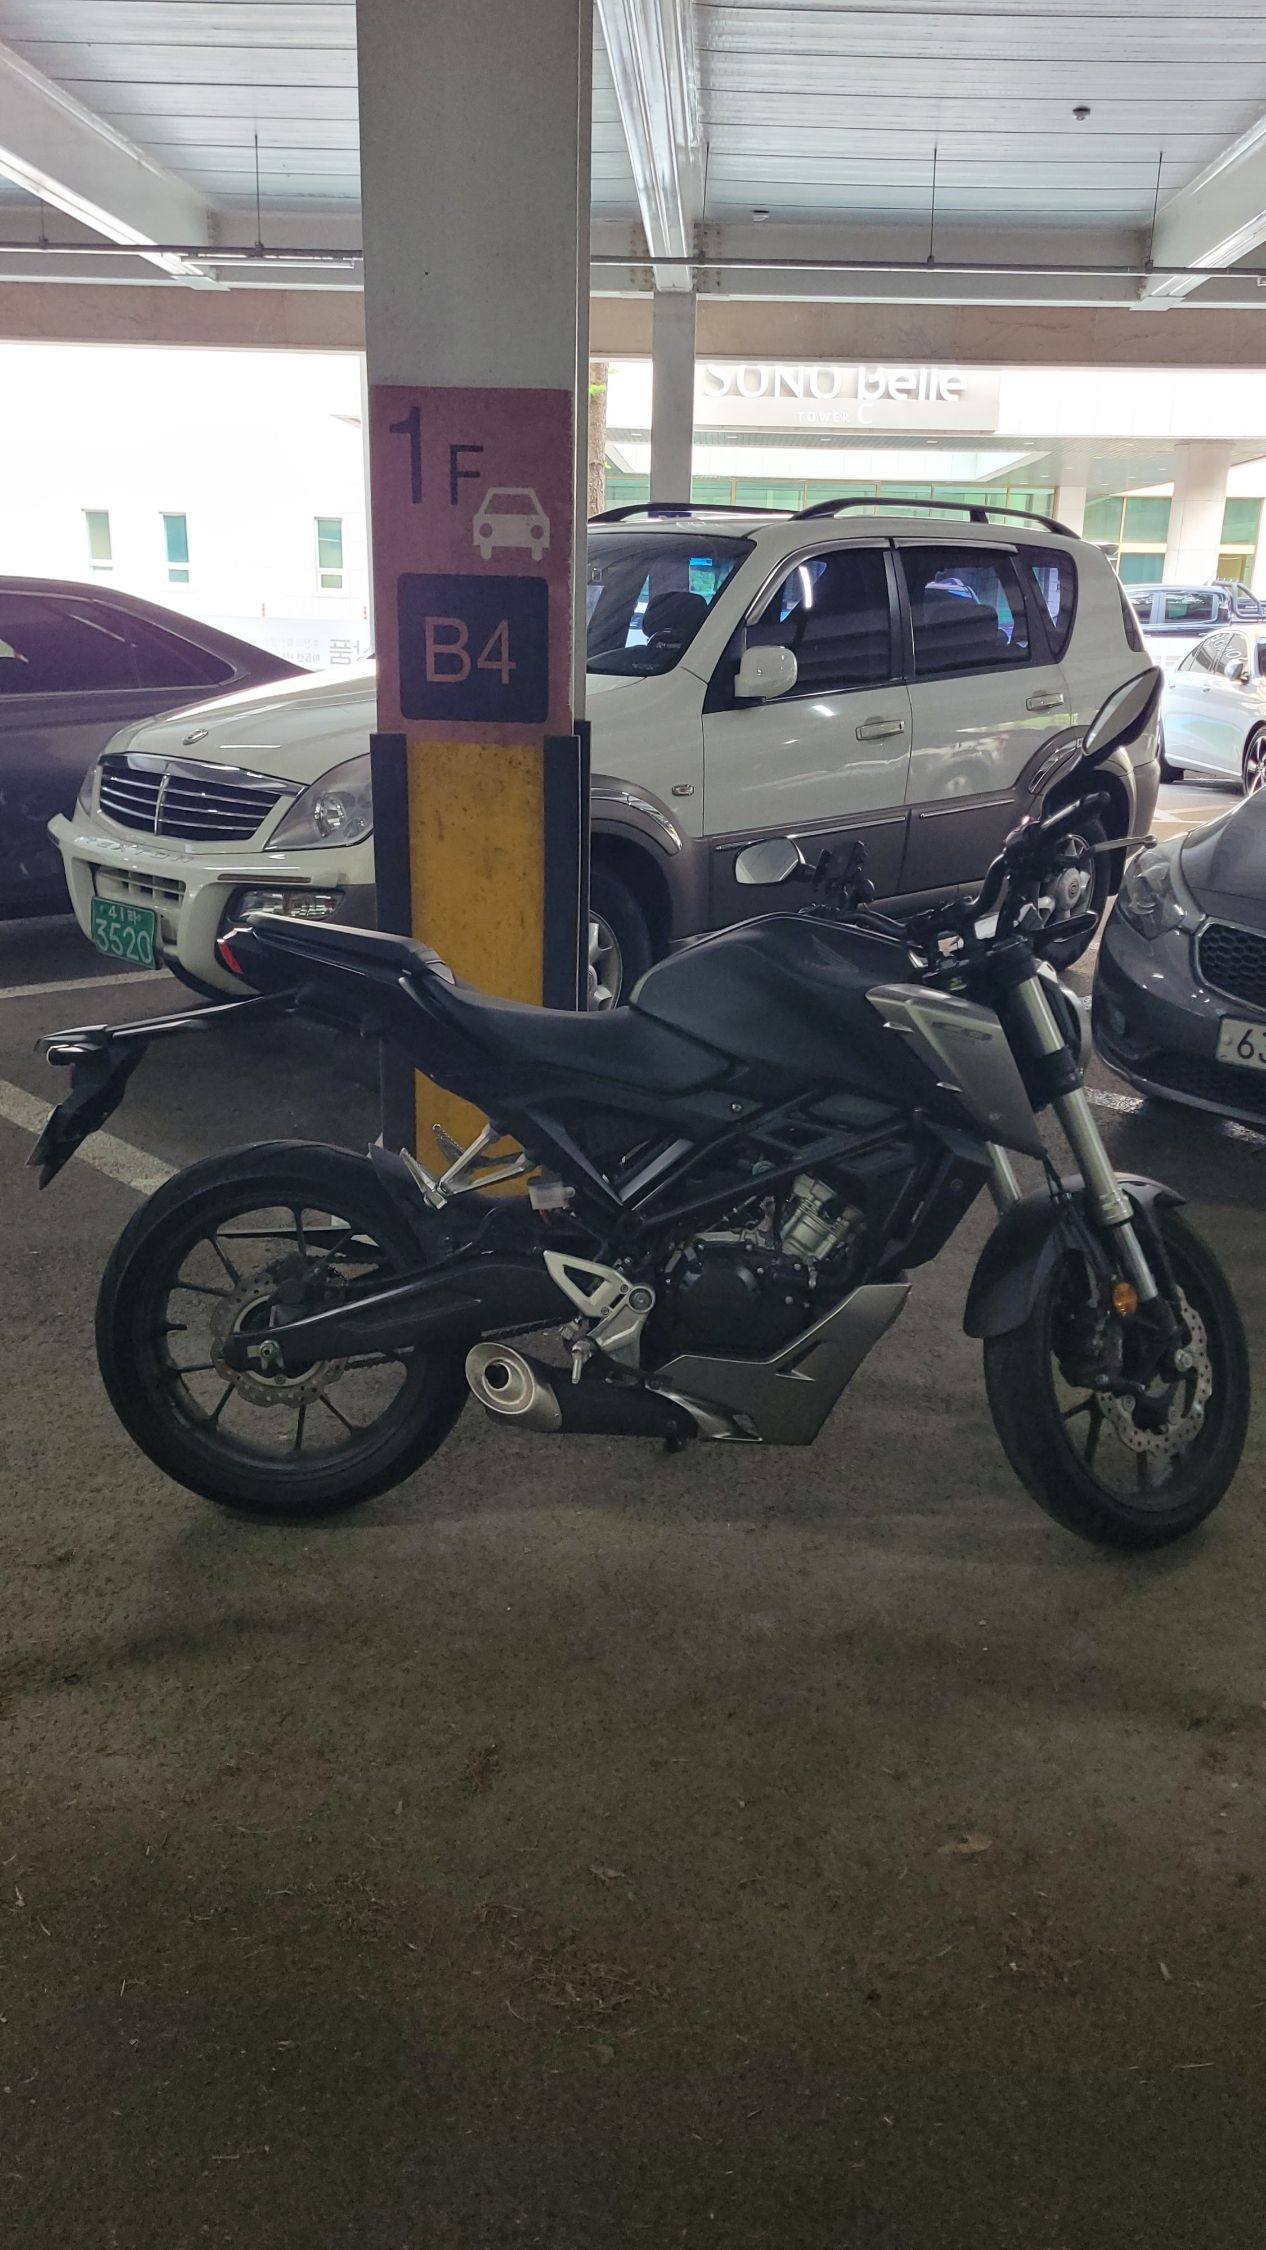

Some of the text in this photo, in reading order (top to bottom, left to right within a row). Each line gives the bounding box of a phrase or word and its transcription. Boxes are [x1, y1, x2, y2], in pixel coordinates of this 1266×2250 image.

[704, 364, 842, 399] SONO
[796, 403, 873, 424] TOWER C
[424, 616, 517, 684] B4
[95, 918, 152, 964] 3520
